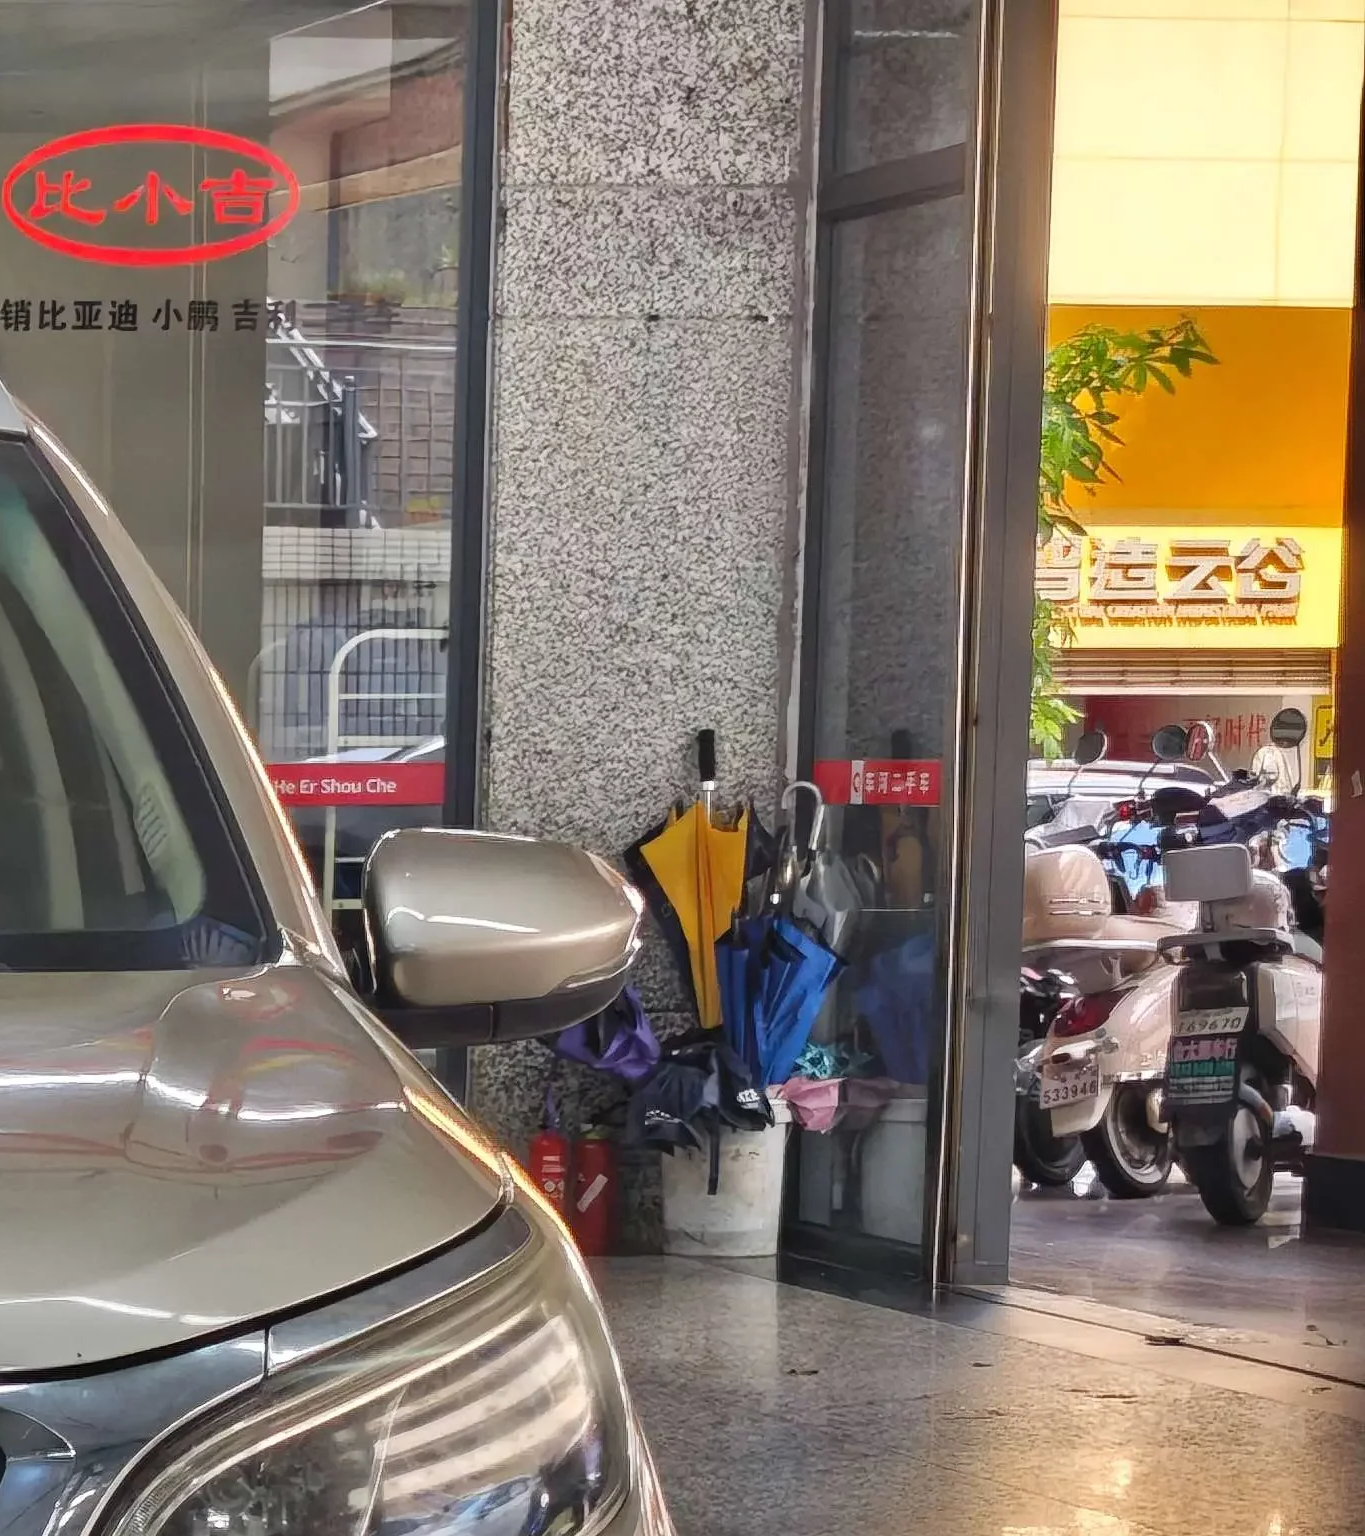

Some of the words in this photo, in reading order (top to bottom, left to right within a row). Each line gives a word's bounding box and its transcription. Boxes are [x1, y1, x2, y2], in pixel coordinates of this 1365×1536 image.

[29, 169, 277, 225] 比小吉
[152, 299, 219, 332] 小鹏
[299, 778, 319, 795] Er
[320, 777, 362, 795] Shou
[365, 776, 398, 794] Che
